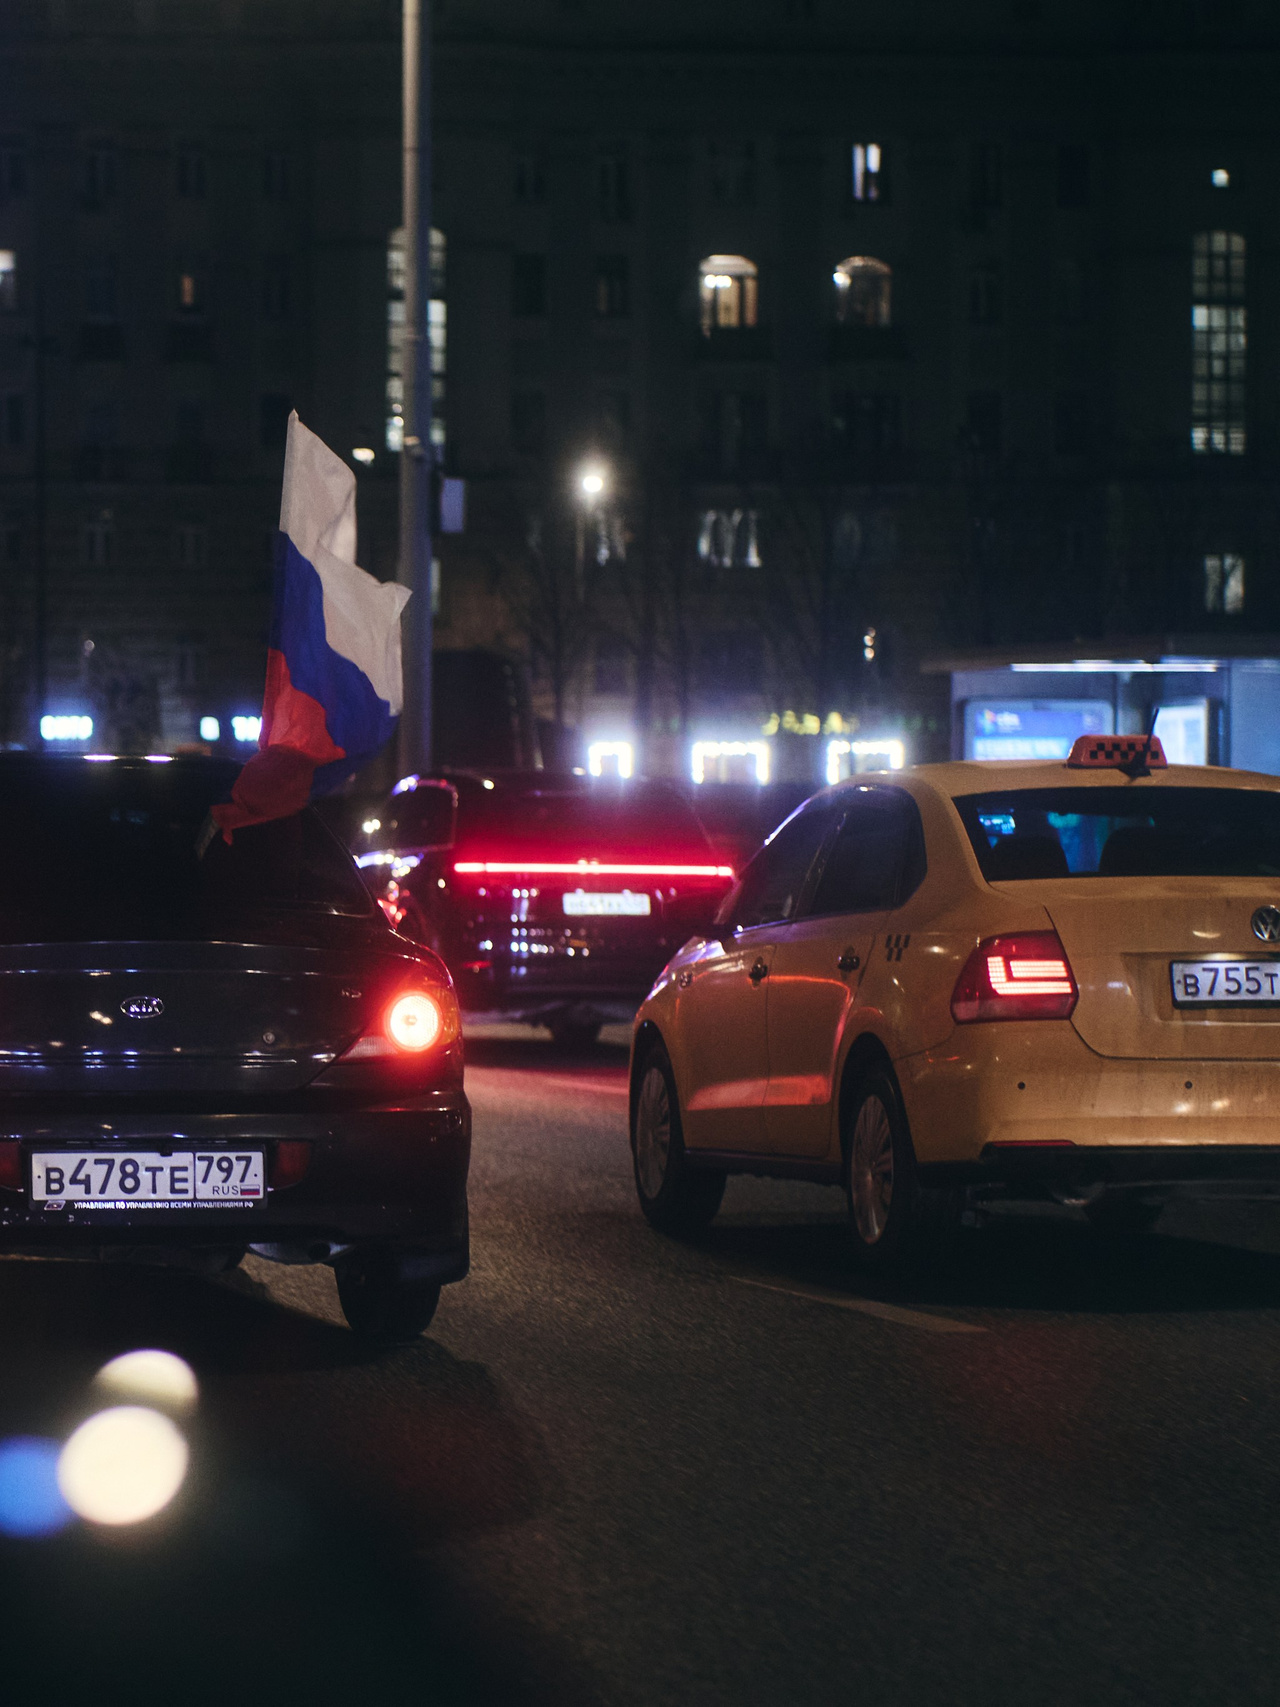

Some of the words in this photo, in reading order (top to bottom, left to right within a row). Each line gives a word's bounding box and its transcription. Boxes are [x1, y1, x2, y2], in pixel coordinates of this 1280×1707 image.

[45, 1158, 189, 1195] В478ТЕ
[197, 1156, 252, 1183] 797
[212, 1185, 238, 1195] RUS
[74, 1201, 115, 1209] УПРАВЛЕНИЕ
[116, 1201, 126, 1209] ПО
